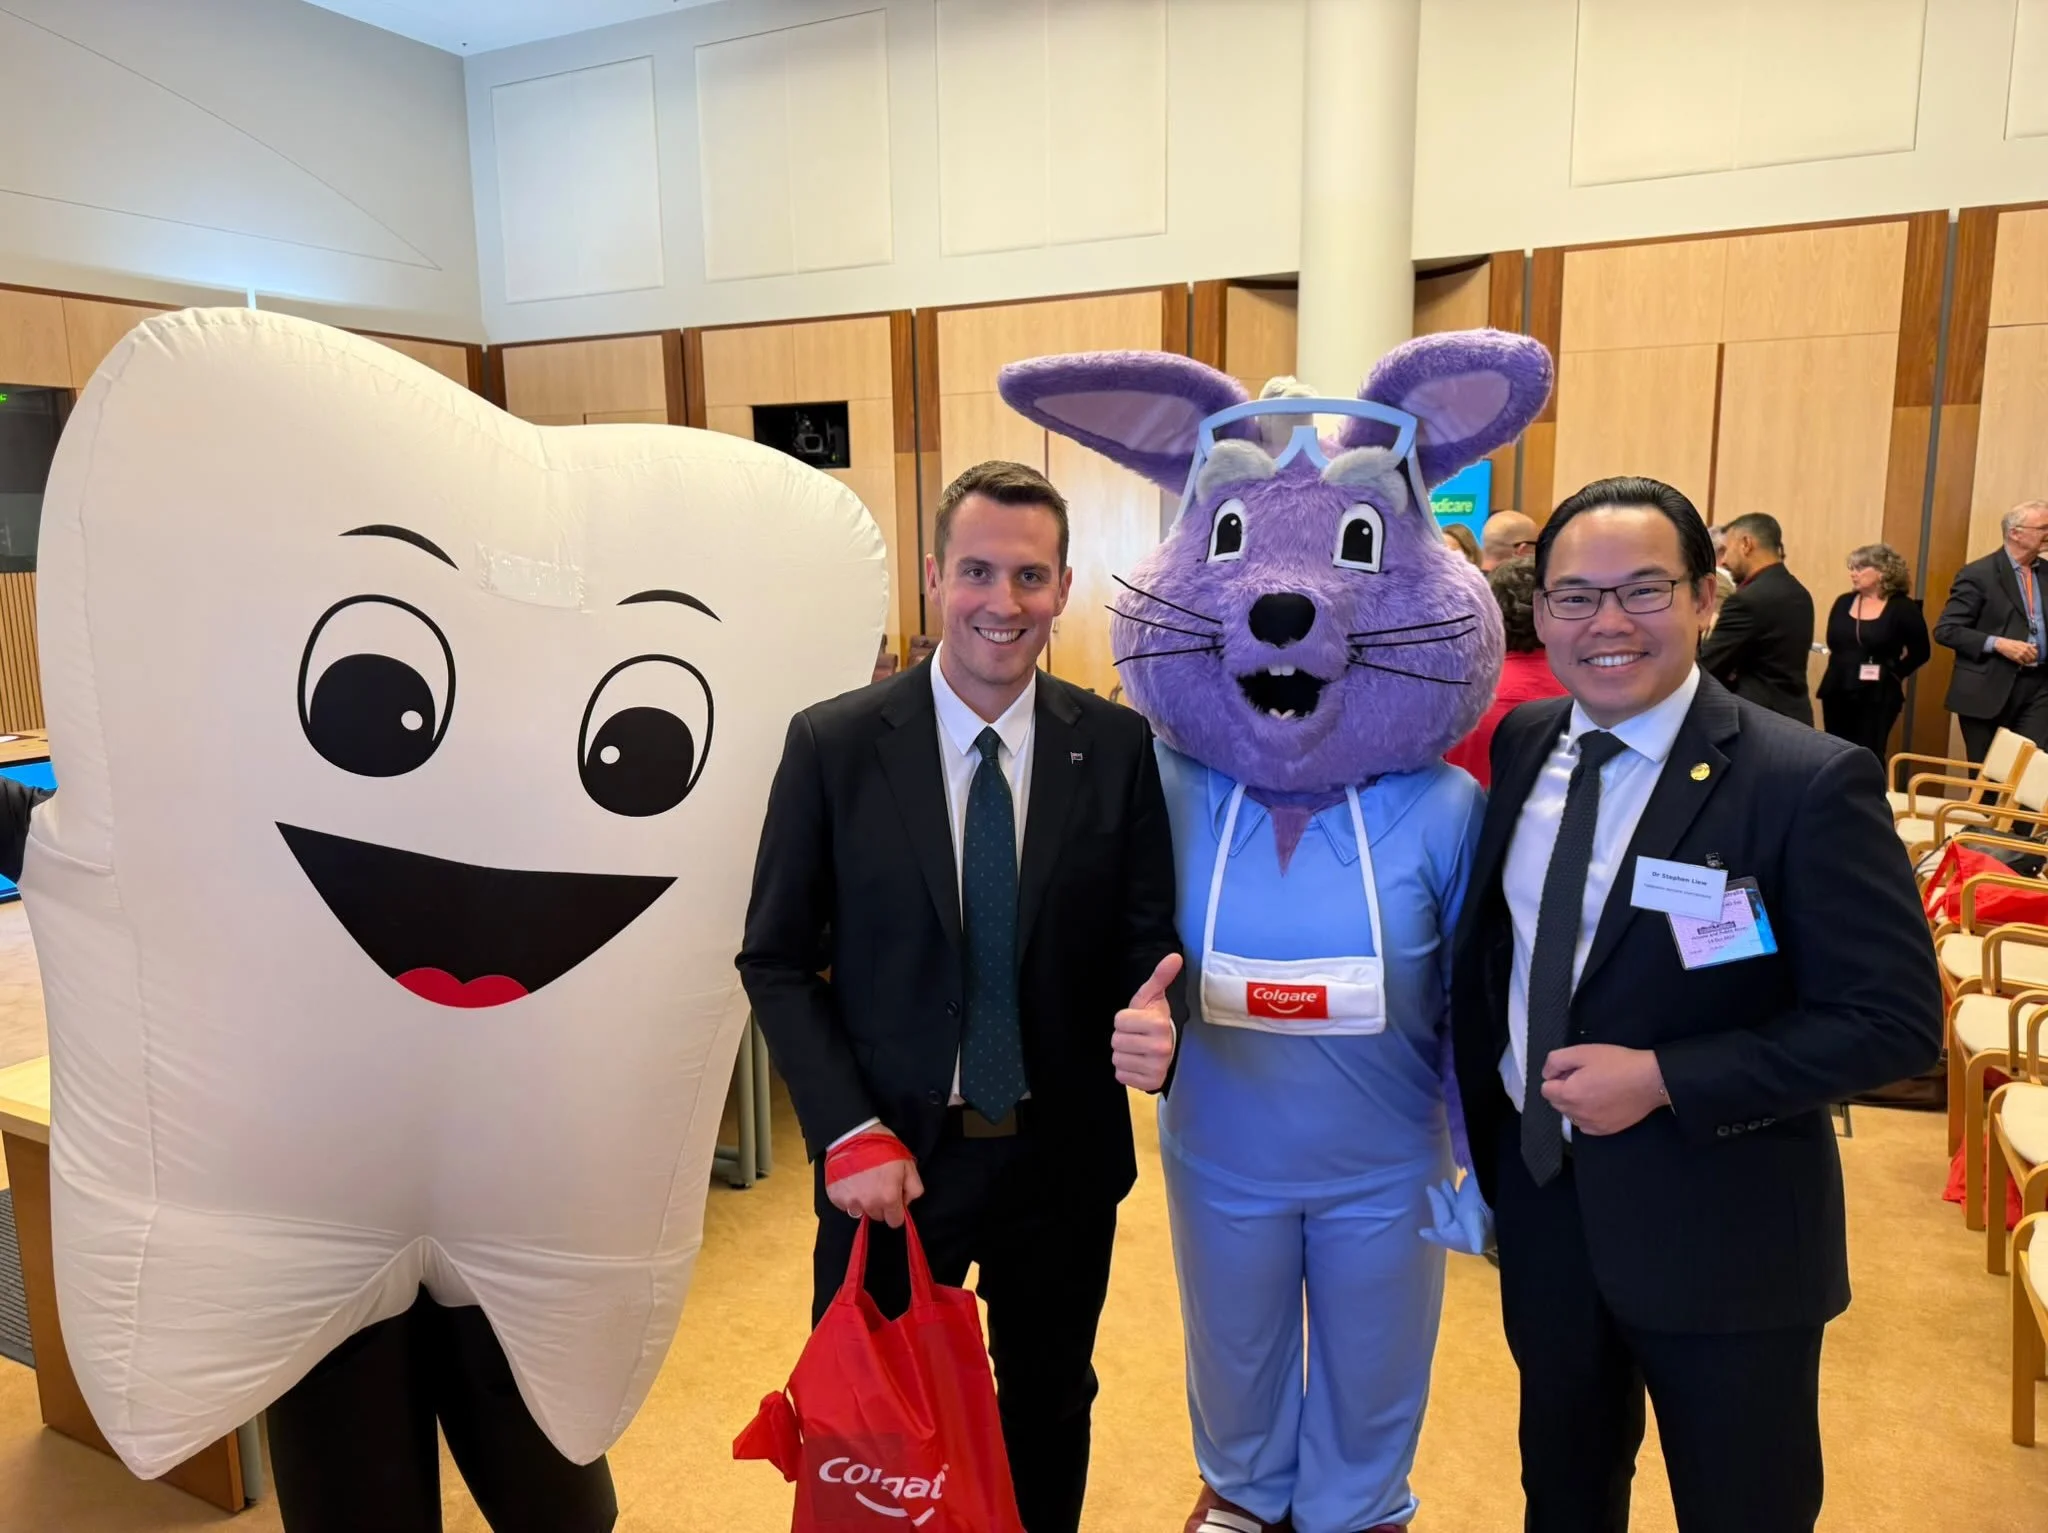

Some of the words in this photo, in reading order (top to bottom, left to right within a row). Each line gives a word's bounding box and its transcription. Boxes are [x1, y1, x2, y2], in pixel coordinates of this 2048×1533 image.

[1430, 498, 1473, 513] edicare
[1662, 873, 1690, 883] Stephen
[1254, 987, 1317, 1003] Colgate
